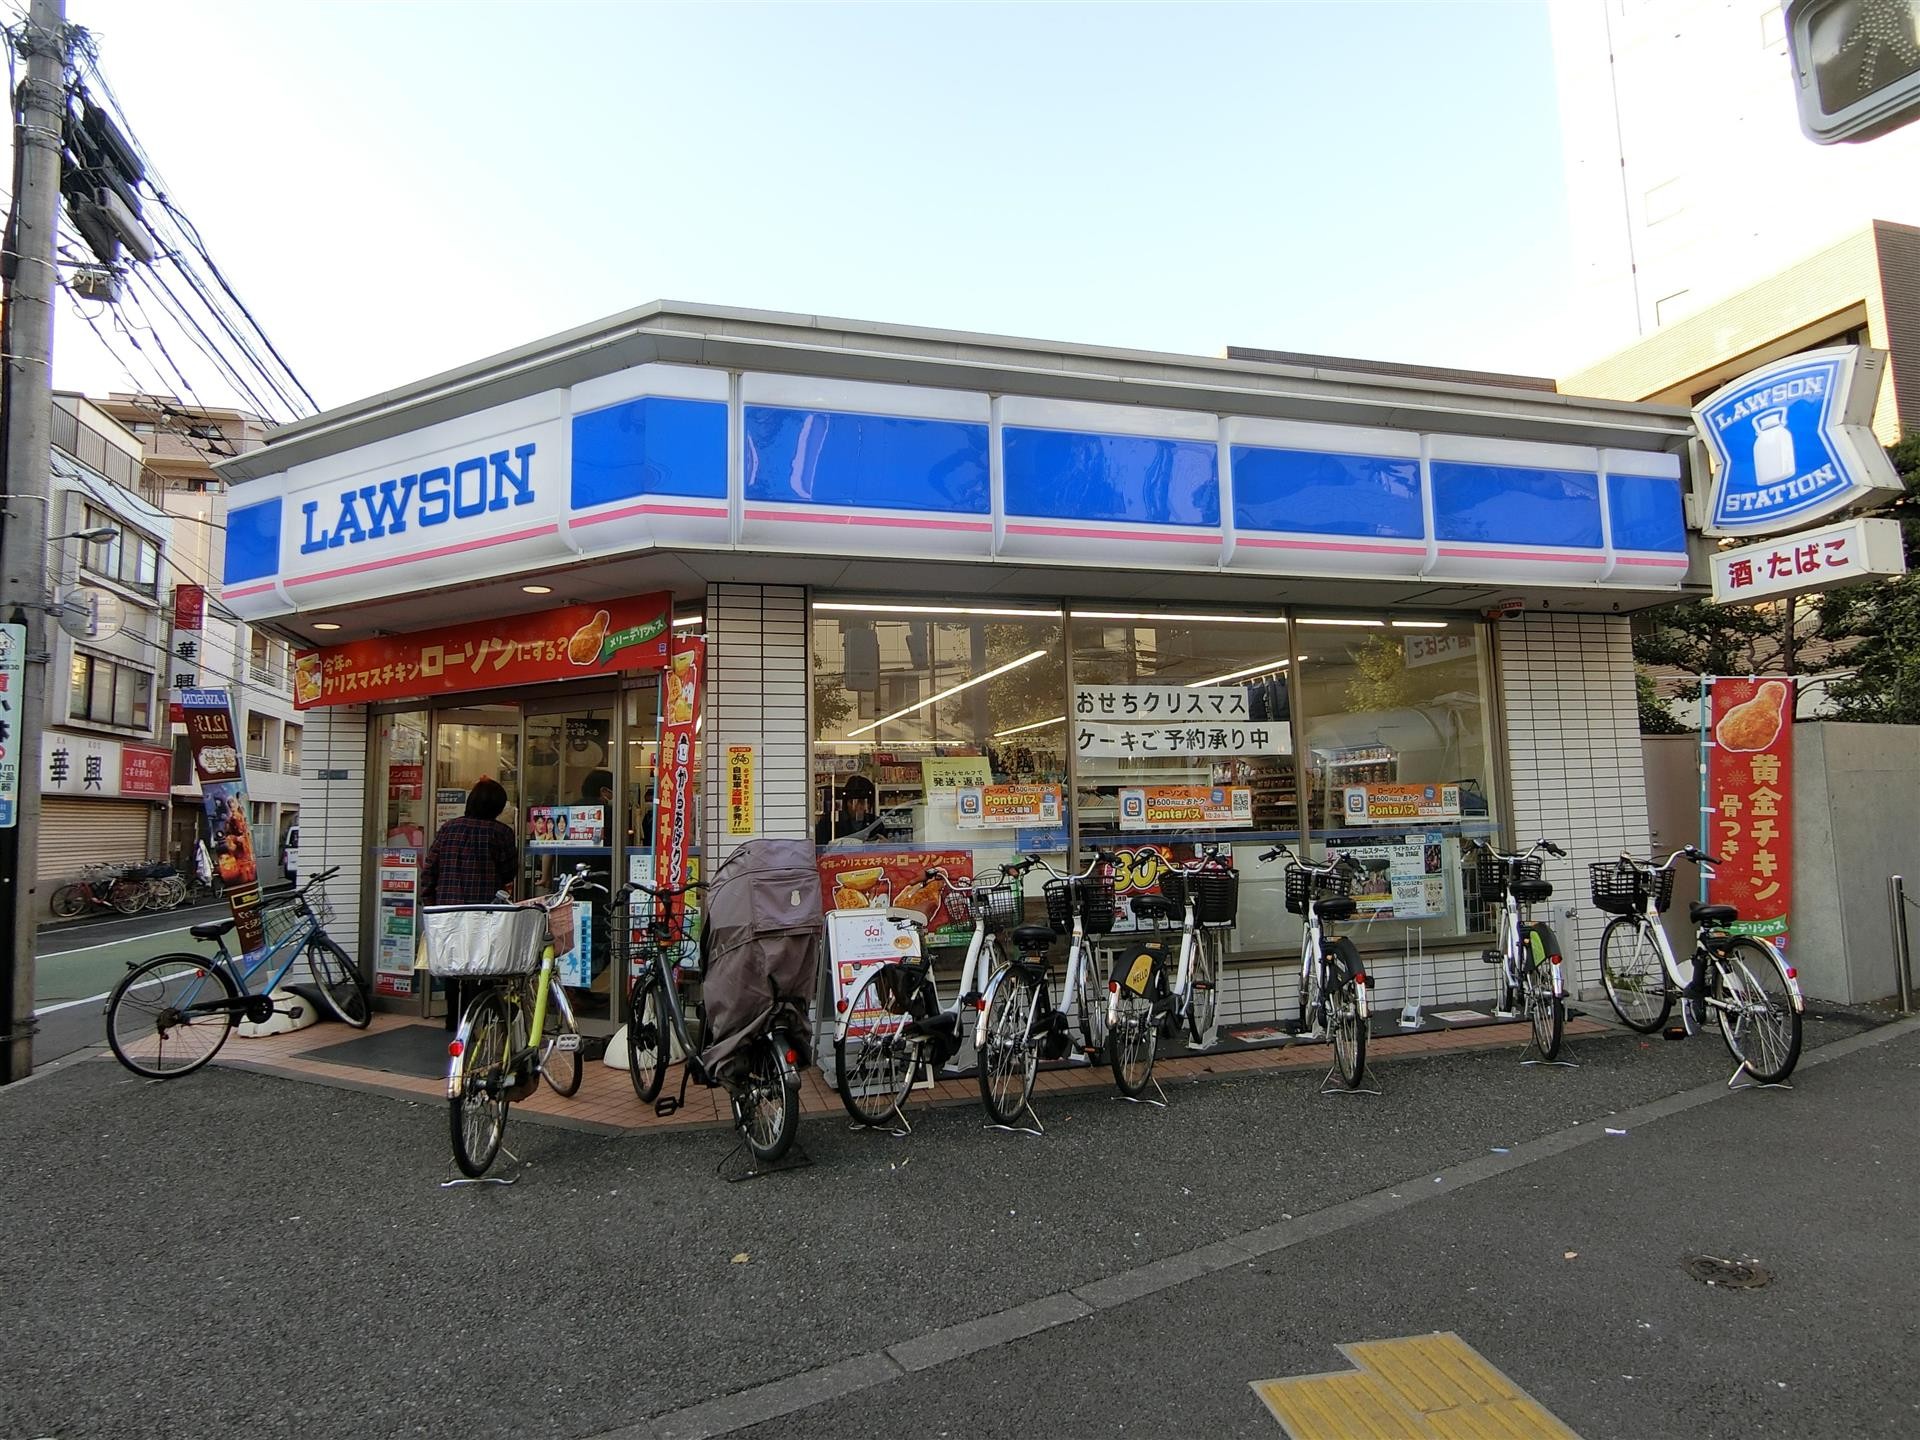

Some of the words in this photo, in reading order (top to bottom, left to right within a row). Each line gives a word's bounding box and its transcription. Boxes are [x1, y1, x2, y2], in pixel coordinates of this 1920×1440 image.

[1715, 376, 1824, 430] LAWSON
[300, 442, 536, 555] LAWSON
[1725, 463, 1837, 512] STATION
[1728, 539, 1849, 589] 酒・たばこ
[323, 654, 353, 675] 今年の
[1076, 692, 1247, 715] おせちクリスマス
[1077, 728, 1269, 751] ケーキご予約承り中
[933, 776, 985, 787] 発送・返品
[985, 794, 1038, 806] Pontaパス
[1368, 804, 1416, 815] Pontaパス
[1147, 808, 1201, 820] Pontaパス
[1719, 794, 1743, 862] 骨つき
[1748, 754, 1783, 901] 黄金チキン
[1132, 968, 1149, 984] HELLO
